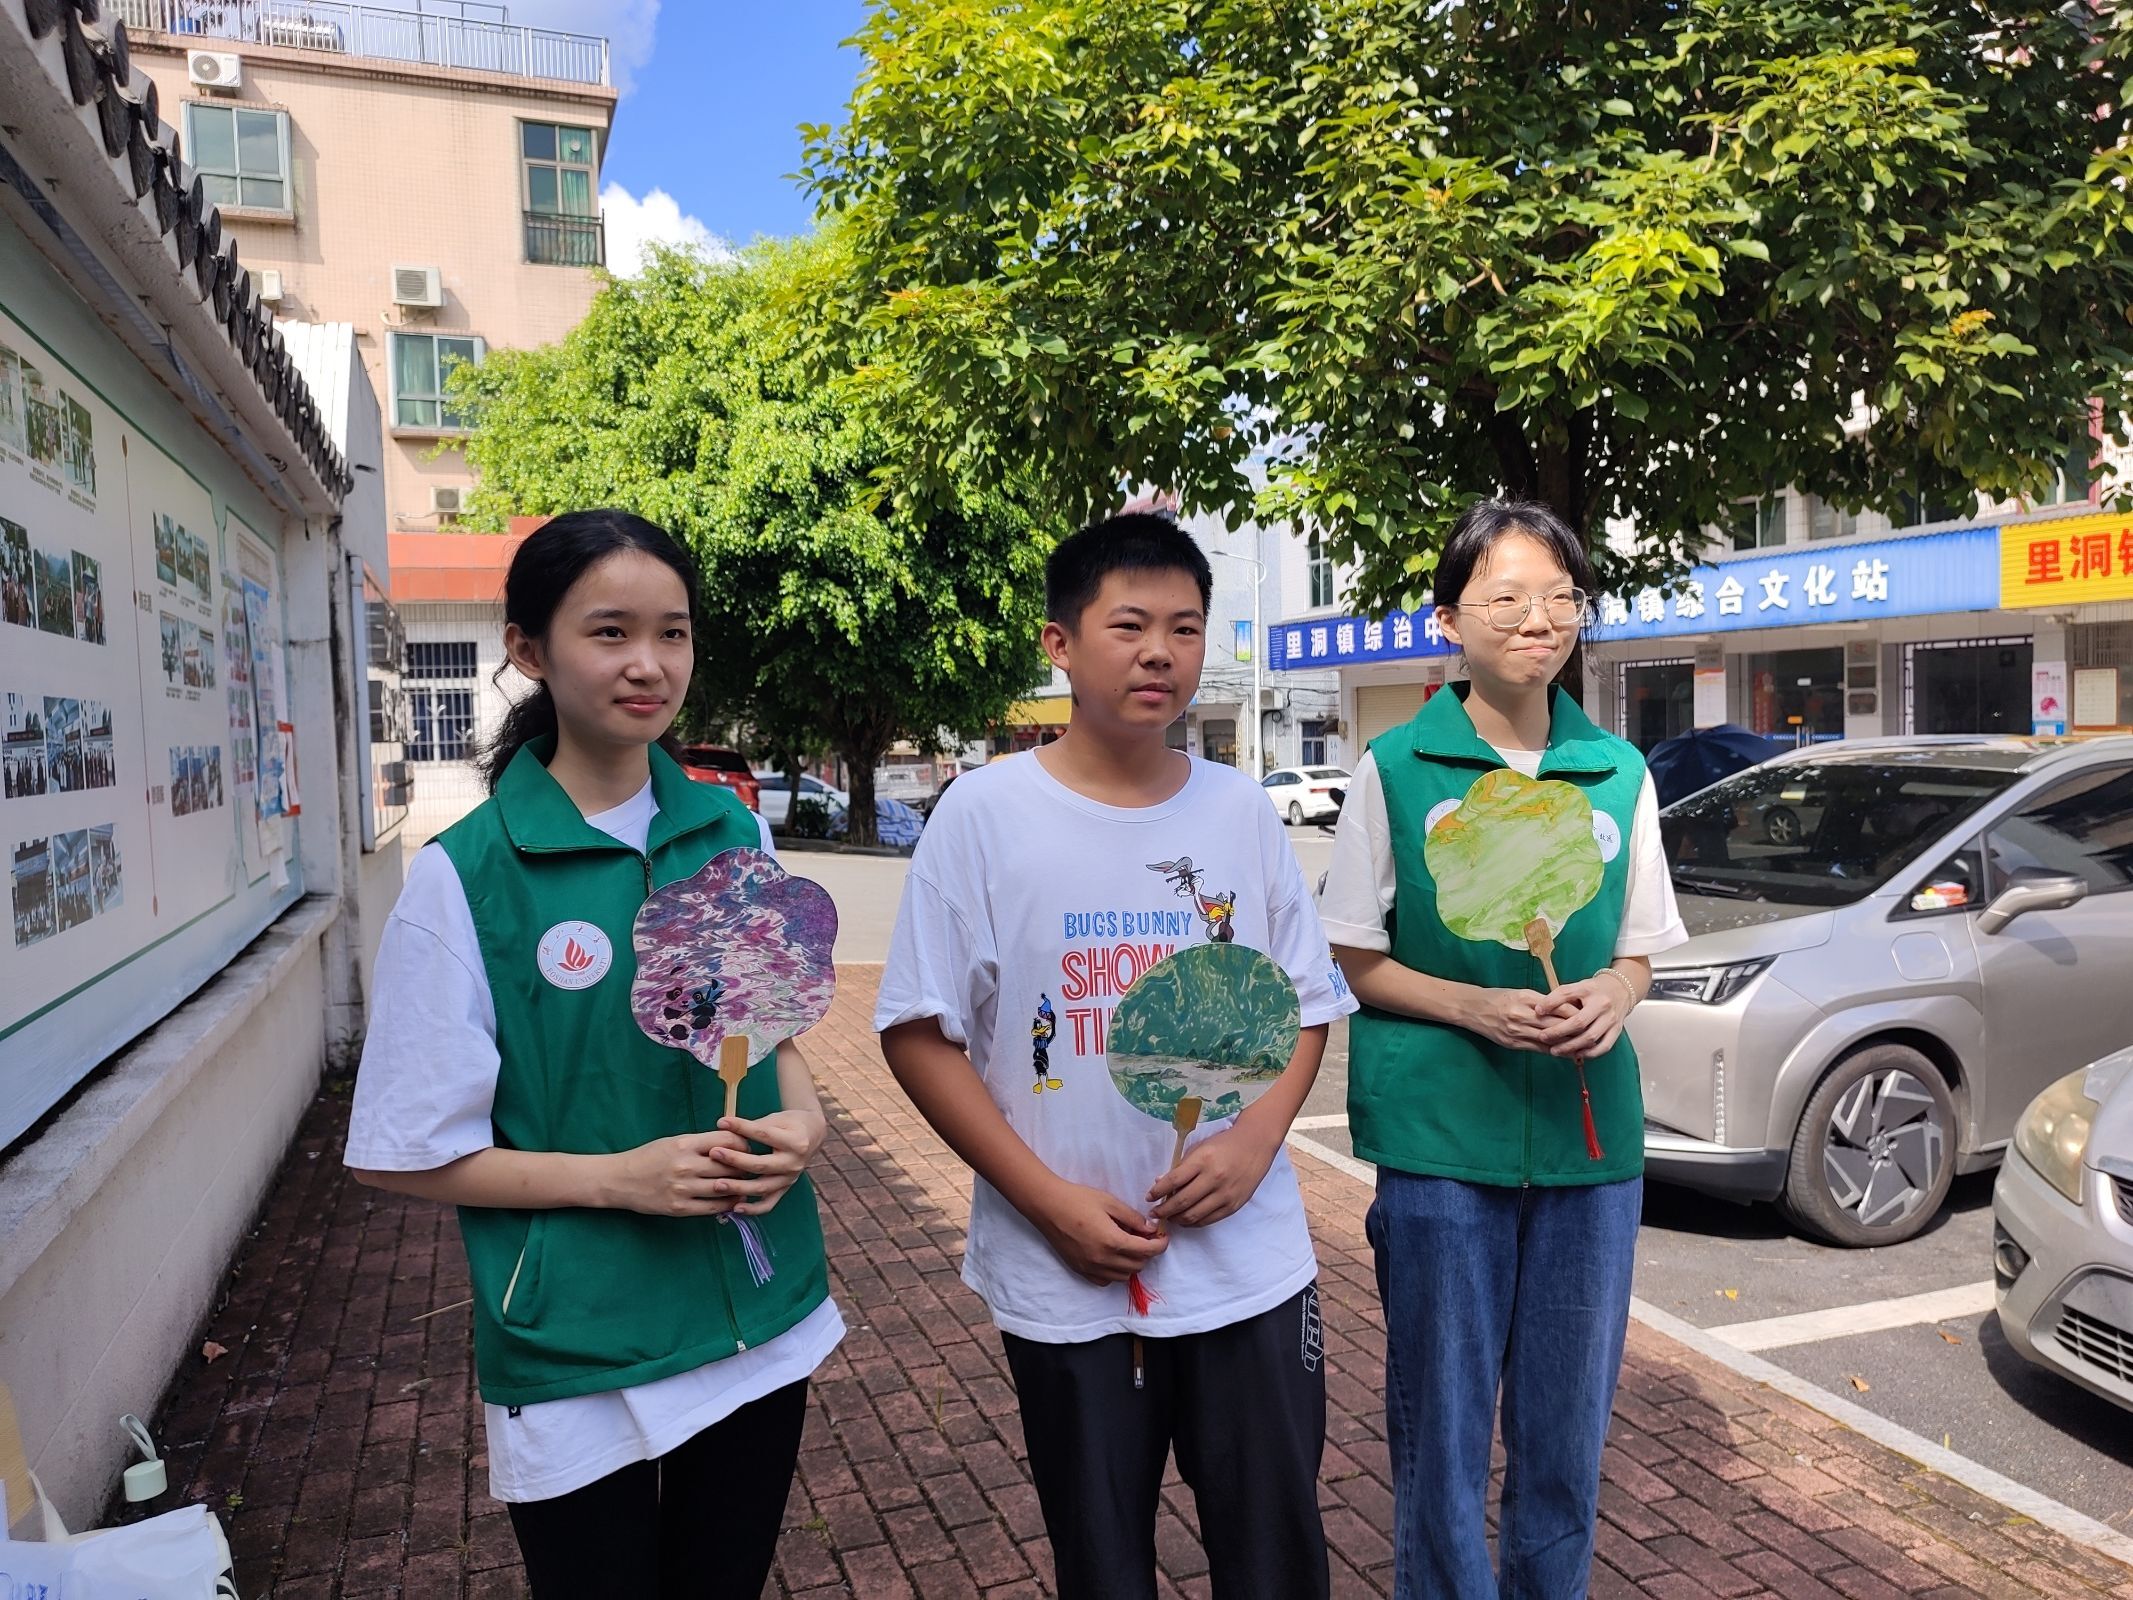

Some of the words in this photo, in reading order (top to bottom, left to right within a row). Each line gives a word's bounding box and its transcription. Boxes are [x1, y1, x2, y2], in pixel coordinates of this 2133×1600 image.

[1582, 558, 1889, 626] 洞镇综合文化站
[1064, 911, 1117, 939] BUGS
[1122, 910, 1192, 936] BUNNY
[1066, 1006, 1116, 1056] TI
